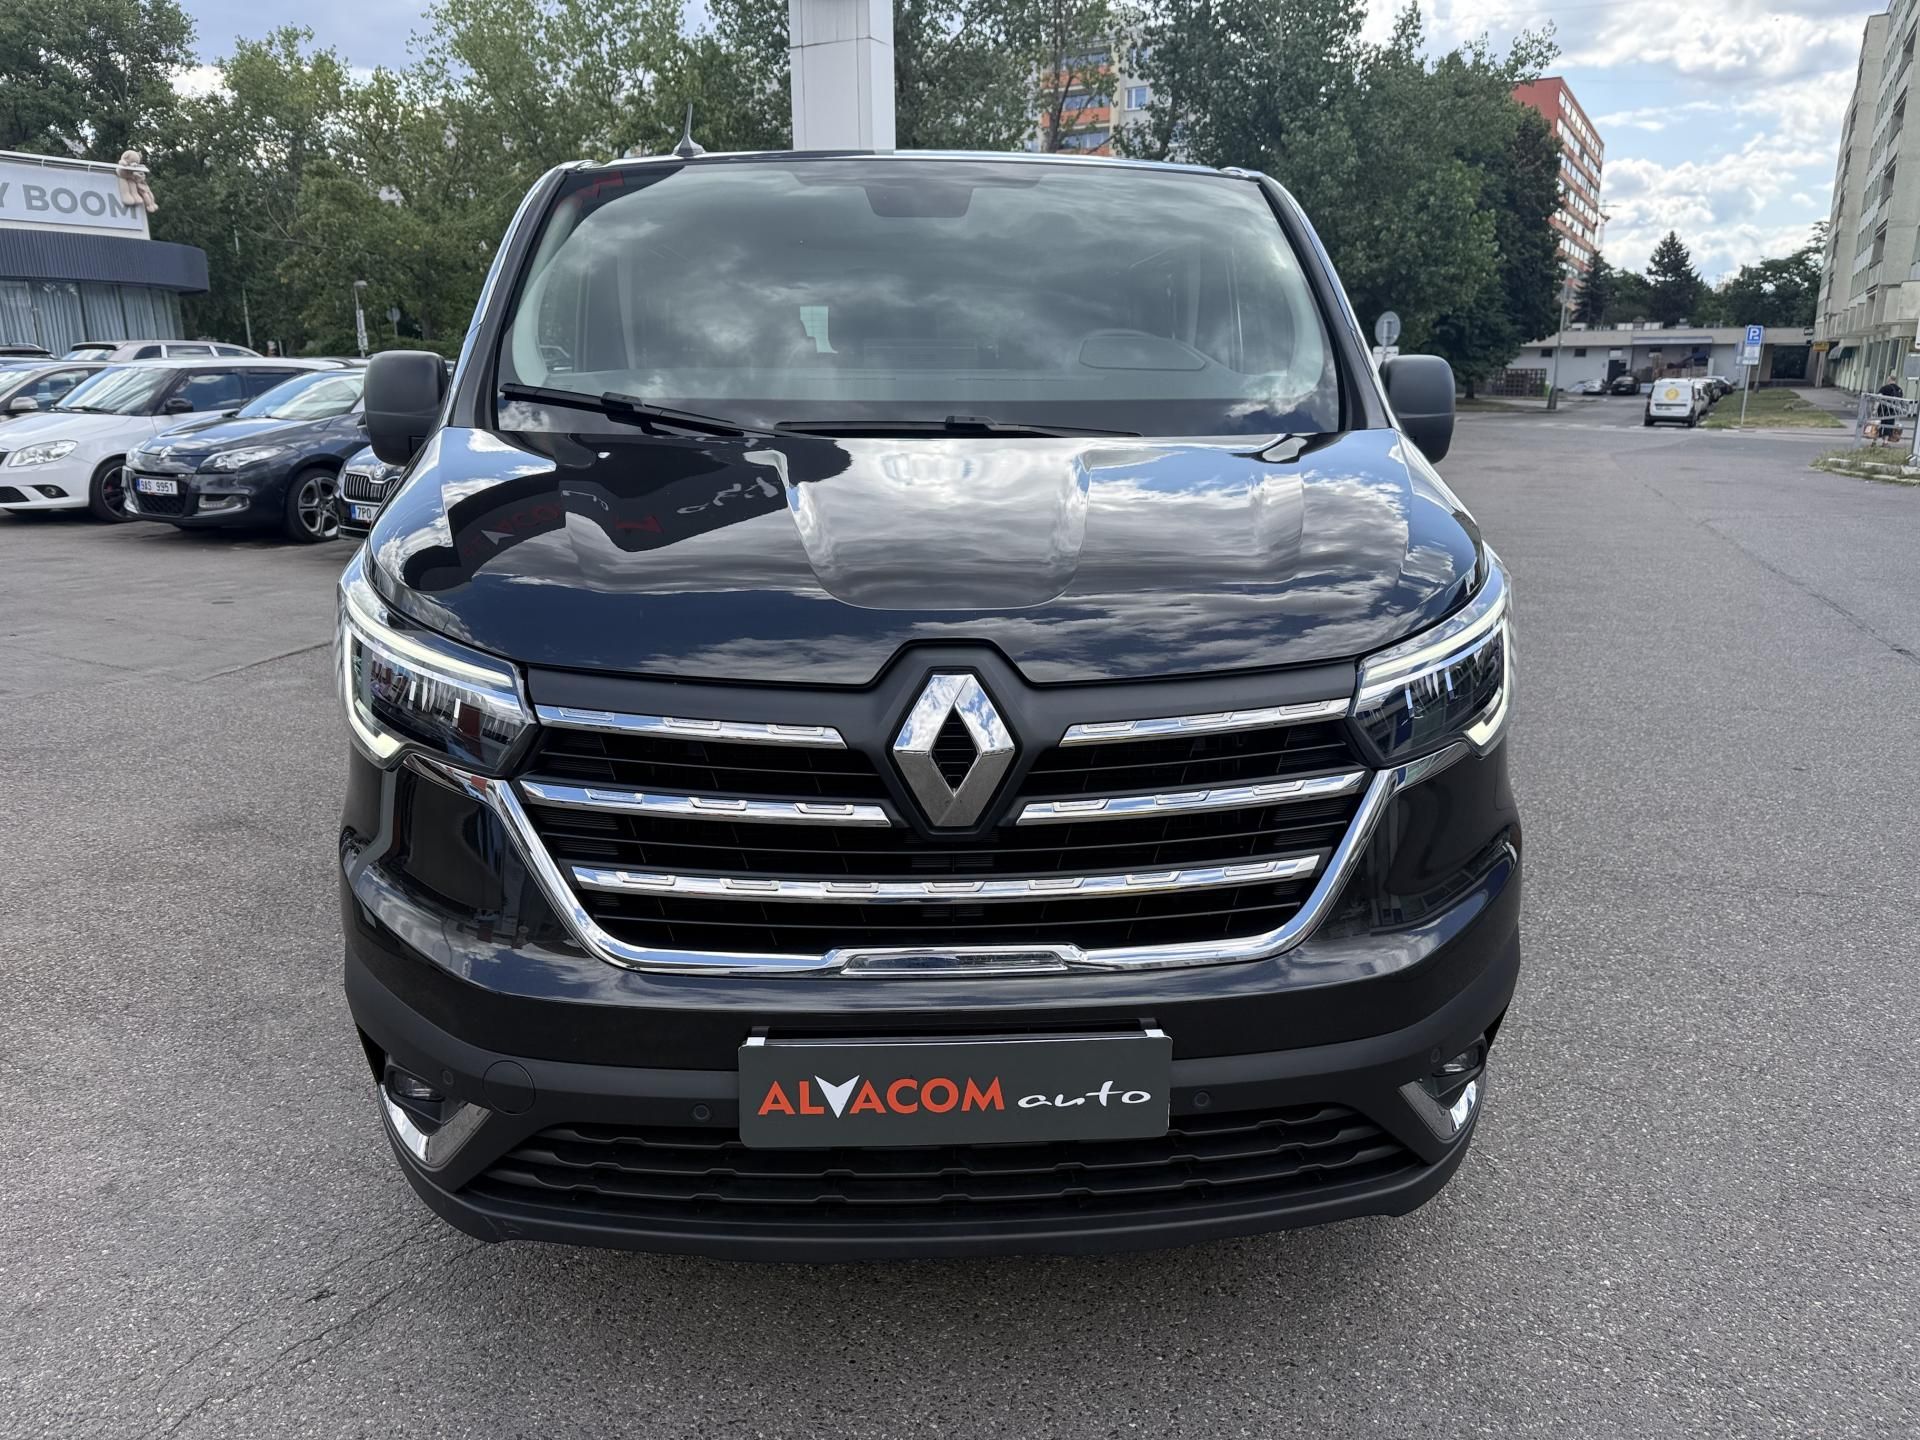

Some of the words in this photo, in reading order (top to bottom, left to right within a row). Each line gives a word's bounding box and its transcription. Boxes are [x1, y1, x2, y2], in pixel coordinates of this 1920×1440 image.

[23, 184, 137, 219] BOOM
[757, 1074, 1005, 1119] ALVACOM
[1017, 1081, 1152, 1109] auto
